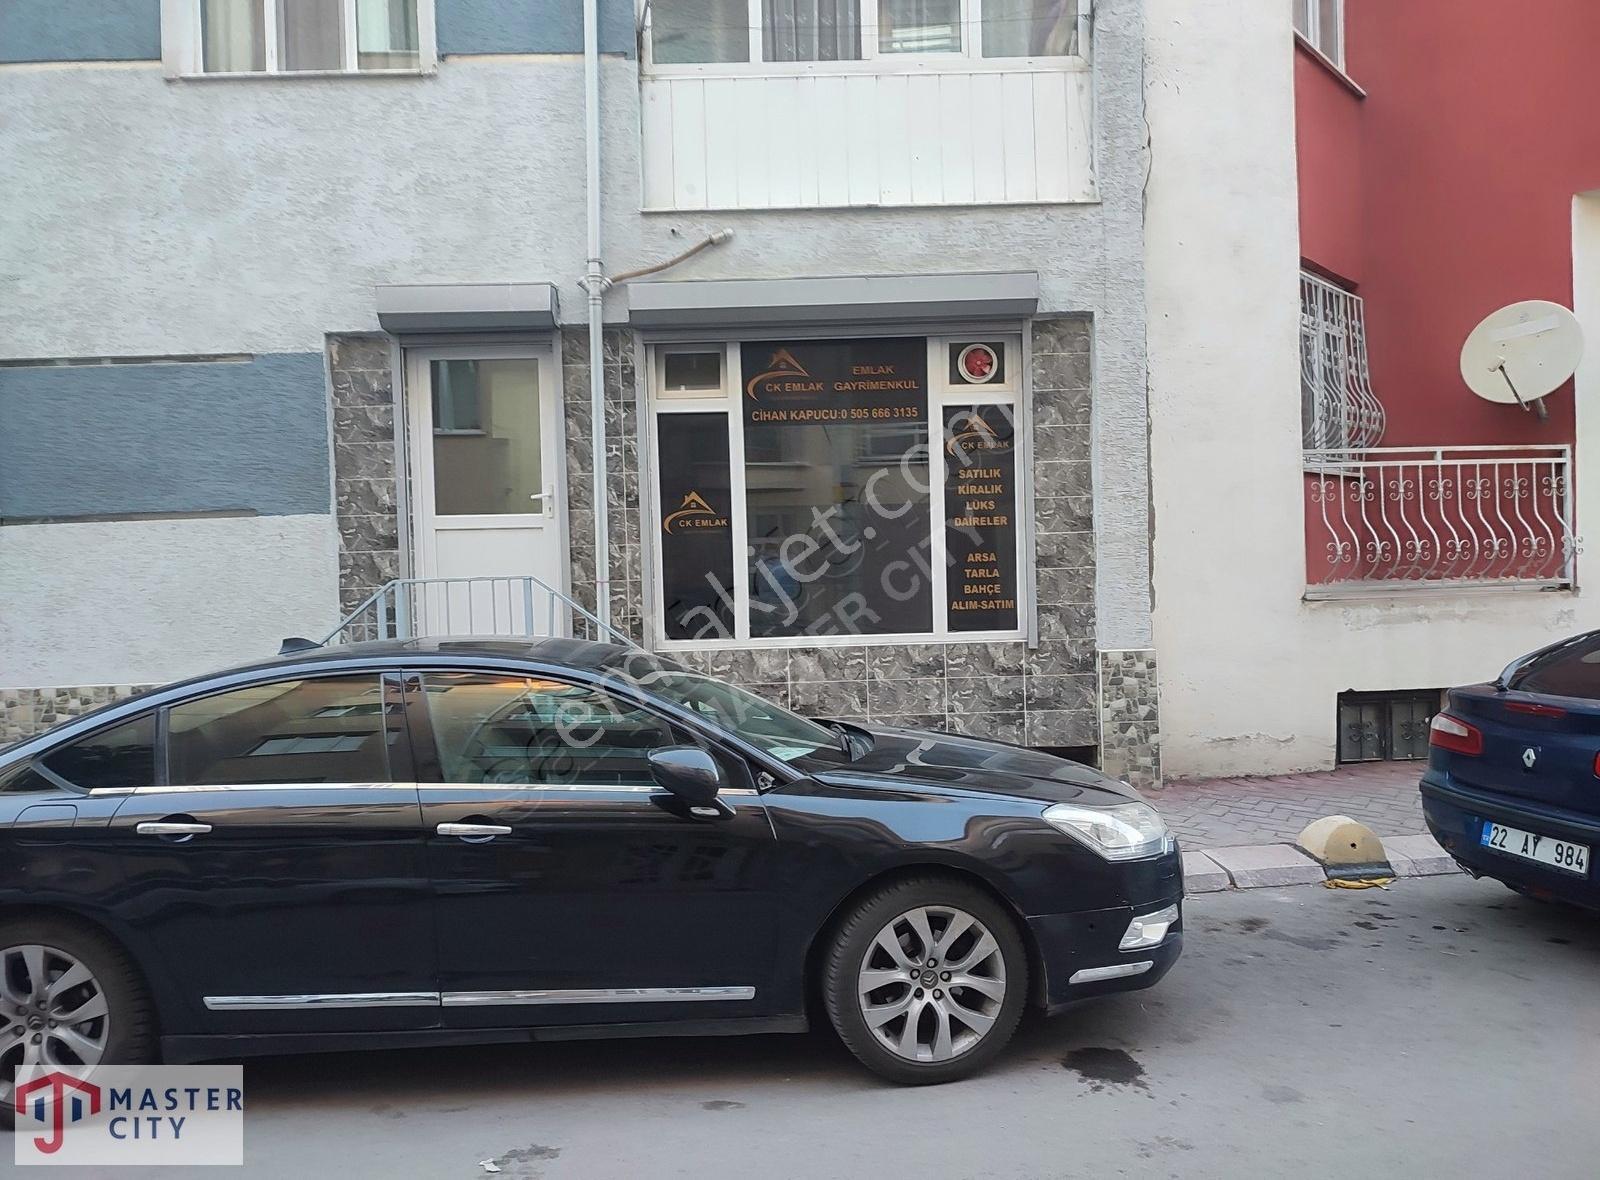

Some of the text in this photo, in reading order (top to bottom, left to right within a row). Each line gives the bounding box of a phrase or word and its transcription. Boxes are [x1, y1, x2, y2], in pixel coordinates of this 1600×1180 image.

[853, 365, 895, 375] EMLAK
[766, 382, 824, 392] CK EMLAK
[834, 379, 919, 391] GAYRİMENKUL
[752, 408, 787, 421] CİHAN
[850, 408, 869, 418] 505
[872, 407, 890, 418] 666
[893, 407, 918, 418] 3135
[961, 442, 975, 450] CK
[959, 469, 1001, 479] SATILIK
[958, 484, 1002, 494] KİRALIK
[695, 519, 728, 527] EMLAK
[967, 553, 997, 562] ARSA
[964, 569, 1000, 578] TARLA
[964, 584, 1001, 595] BAHÇE
[952, 600, 1014, 610] ALIM-SATIM
[1490, 826, 1508, 848] 22
[1521, 834, 1541, 856] AY
[1554, 843, 1584, 870] 984
